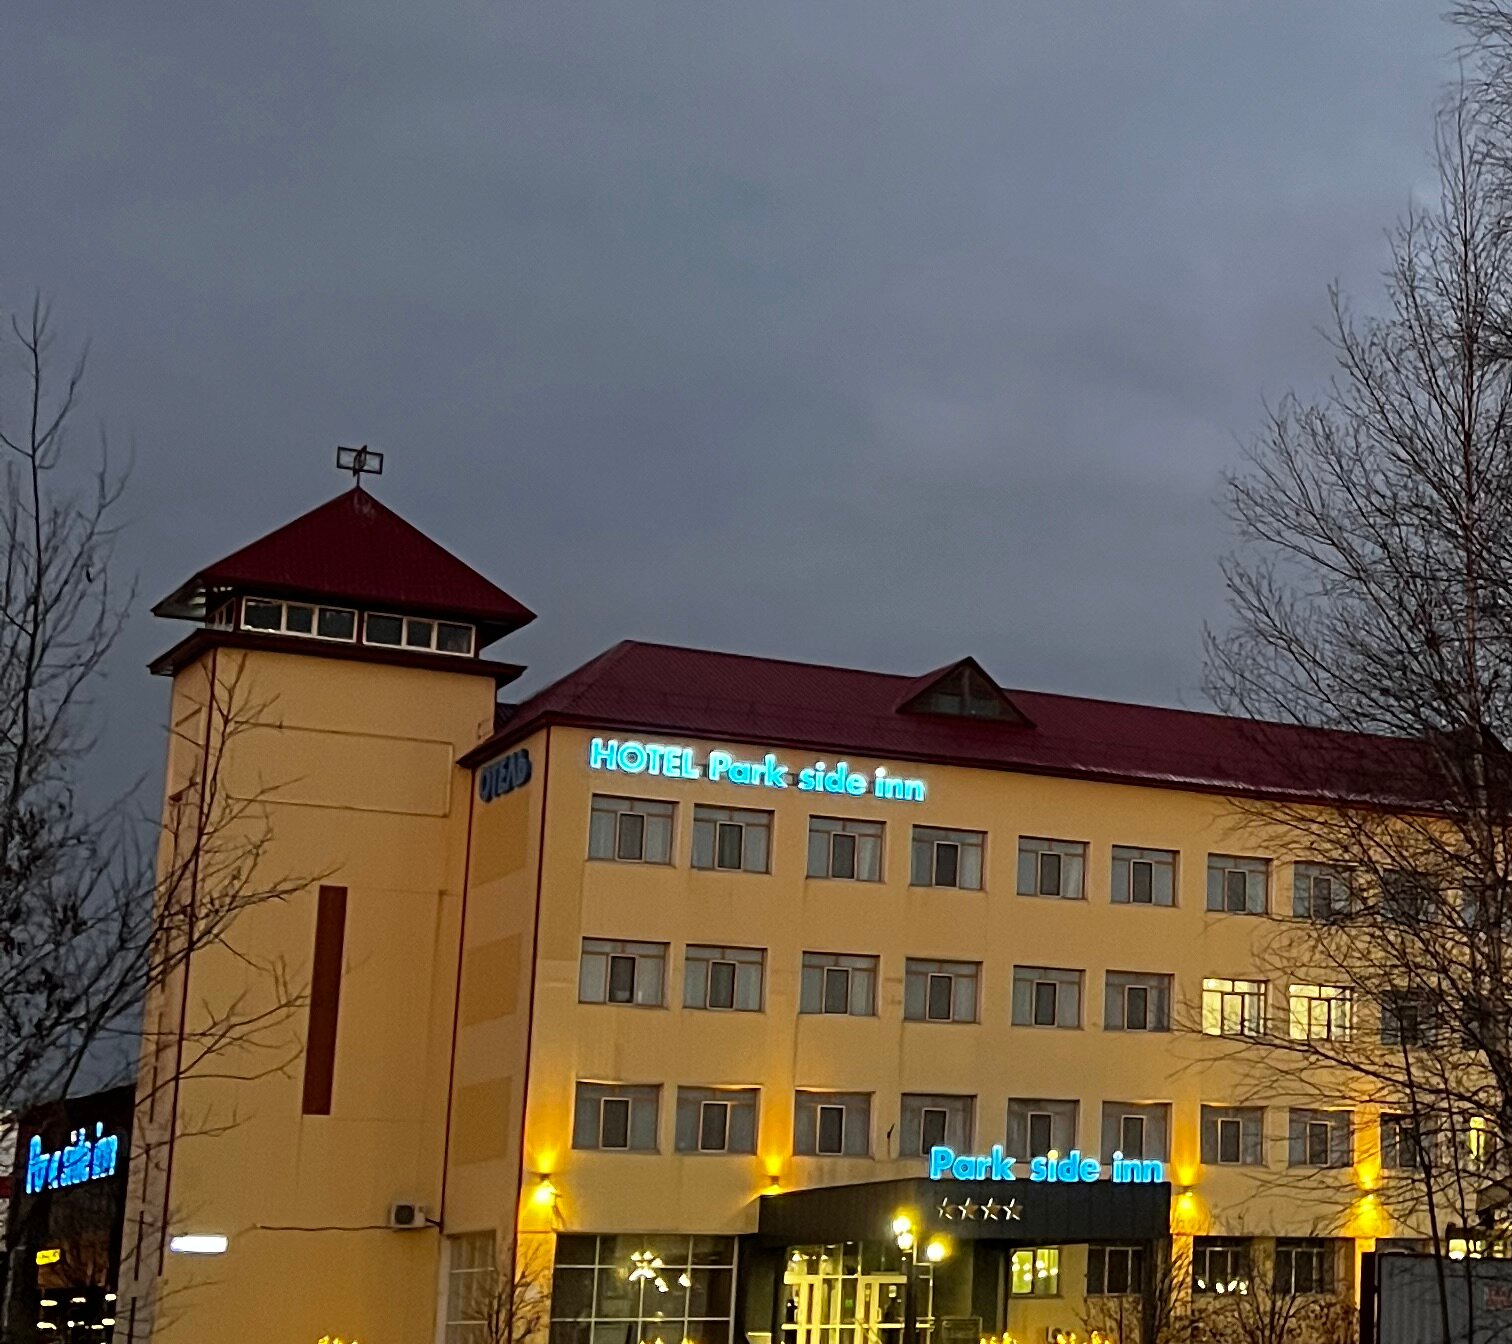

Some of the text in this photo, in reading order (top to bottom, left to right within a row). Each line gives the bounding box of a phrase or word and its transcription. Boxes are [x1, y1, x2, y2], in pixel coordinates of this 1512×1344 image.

[589, 737, 926, 802] HOTEL Park side inn
[929, 1144, 1165, 1183] Park side inn
